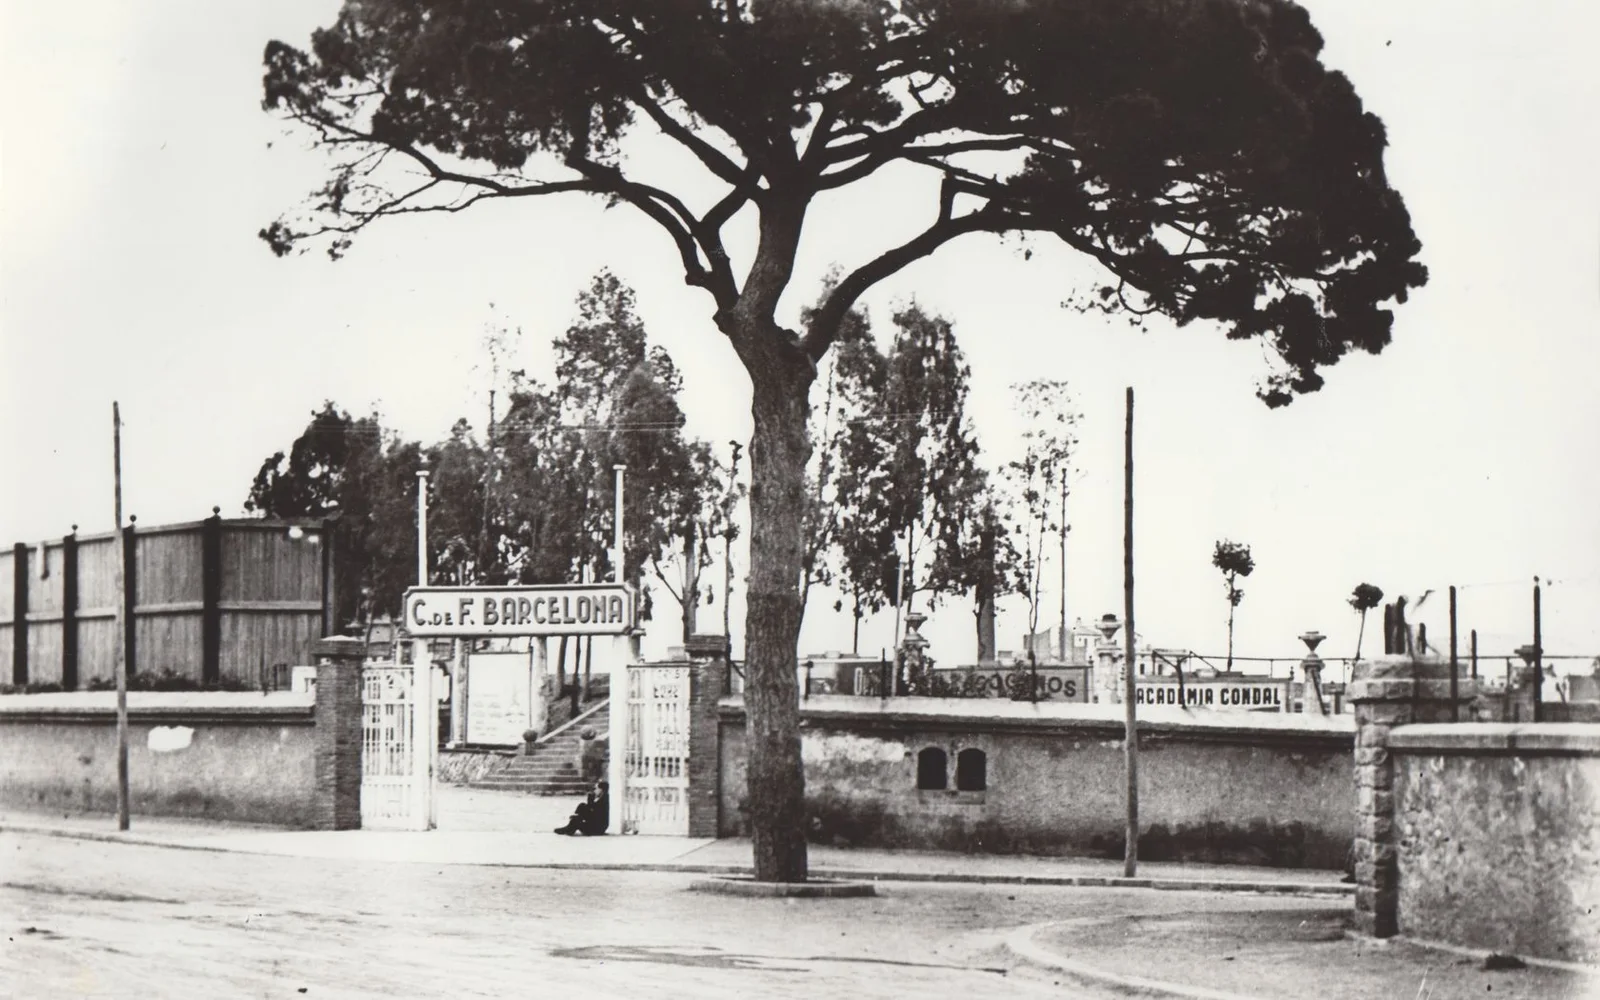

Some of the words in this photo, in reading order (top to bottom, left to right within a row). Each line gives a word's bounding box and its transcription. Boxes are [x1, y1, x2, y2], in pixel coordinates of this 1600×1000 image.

[458, 597, 475, 625] F.
[482, 594, 623, 625] BARCELONA
[1220, 688, 1281, 705] CONDAL
